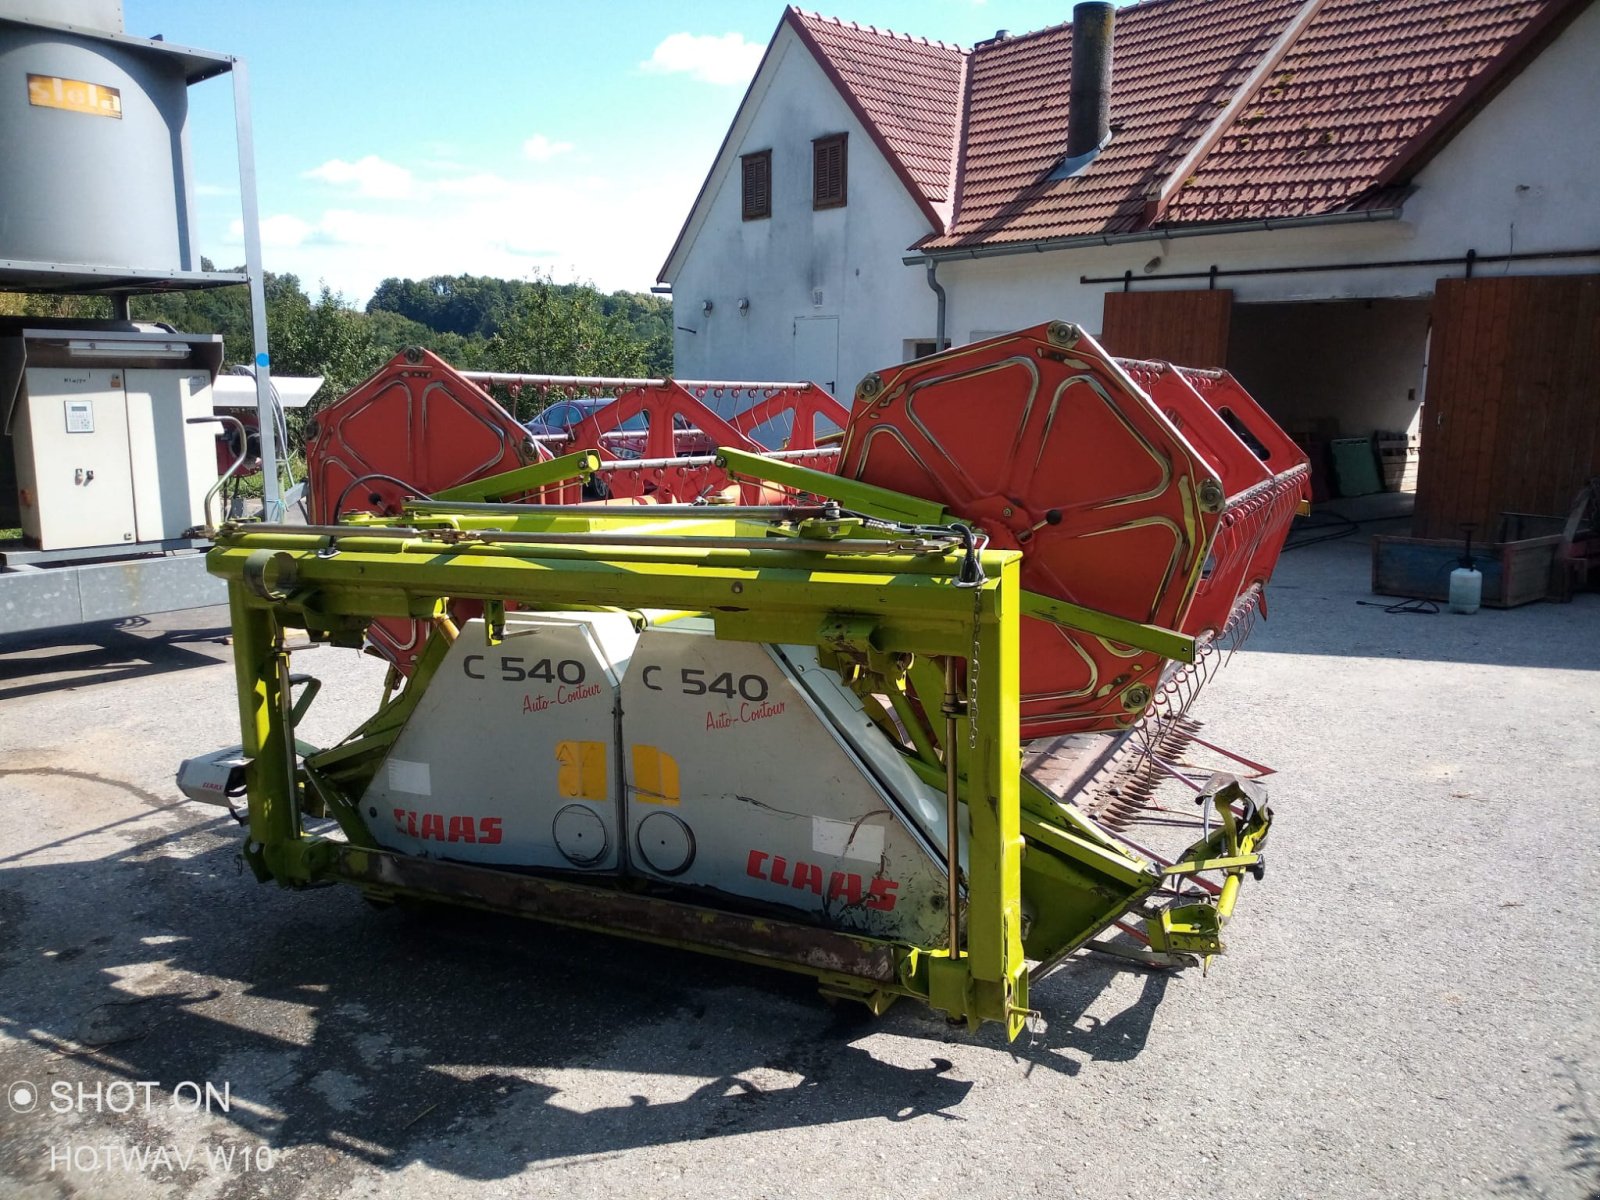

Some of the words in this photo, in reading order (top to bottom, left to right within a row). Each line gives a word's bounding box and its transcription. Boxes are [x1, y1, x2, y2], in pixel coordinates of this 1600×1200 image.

[463, 654, 485, 680] C
[500, 656, 586, 685] 540
[642, 665, 663, 691] C
[681, 668, 769, 702] 540
[522, 681, 602, 715] Auto-Contour
[705, 701, 786, 731] Auto-Contour
[393, 808, 503, 845] CLAAS
[746, 849, 899, 912] CLAAS
